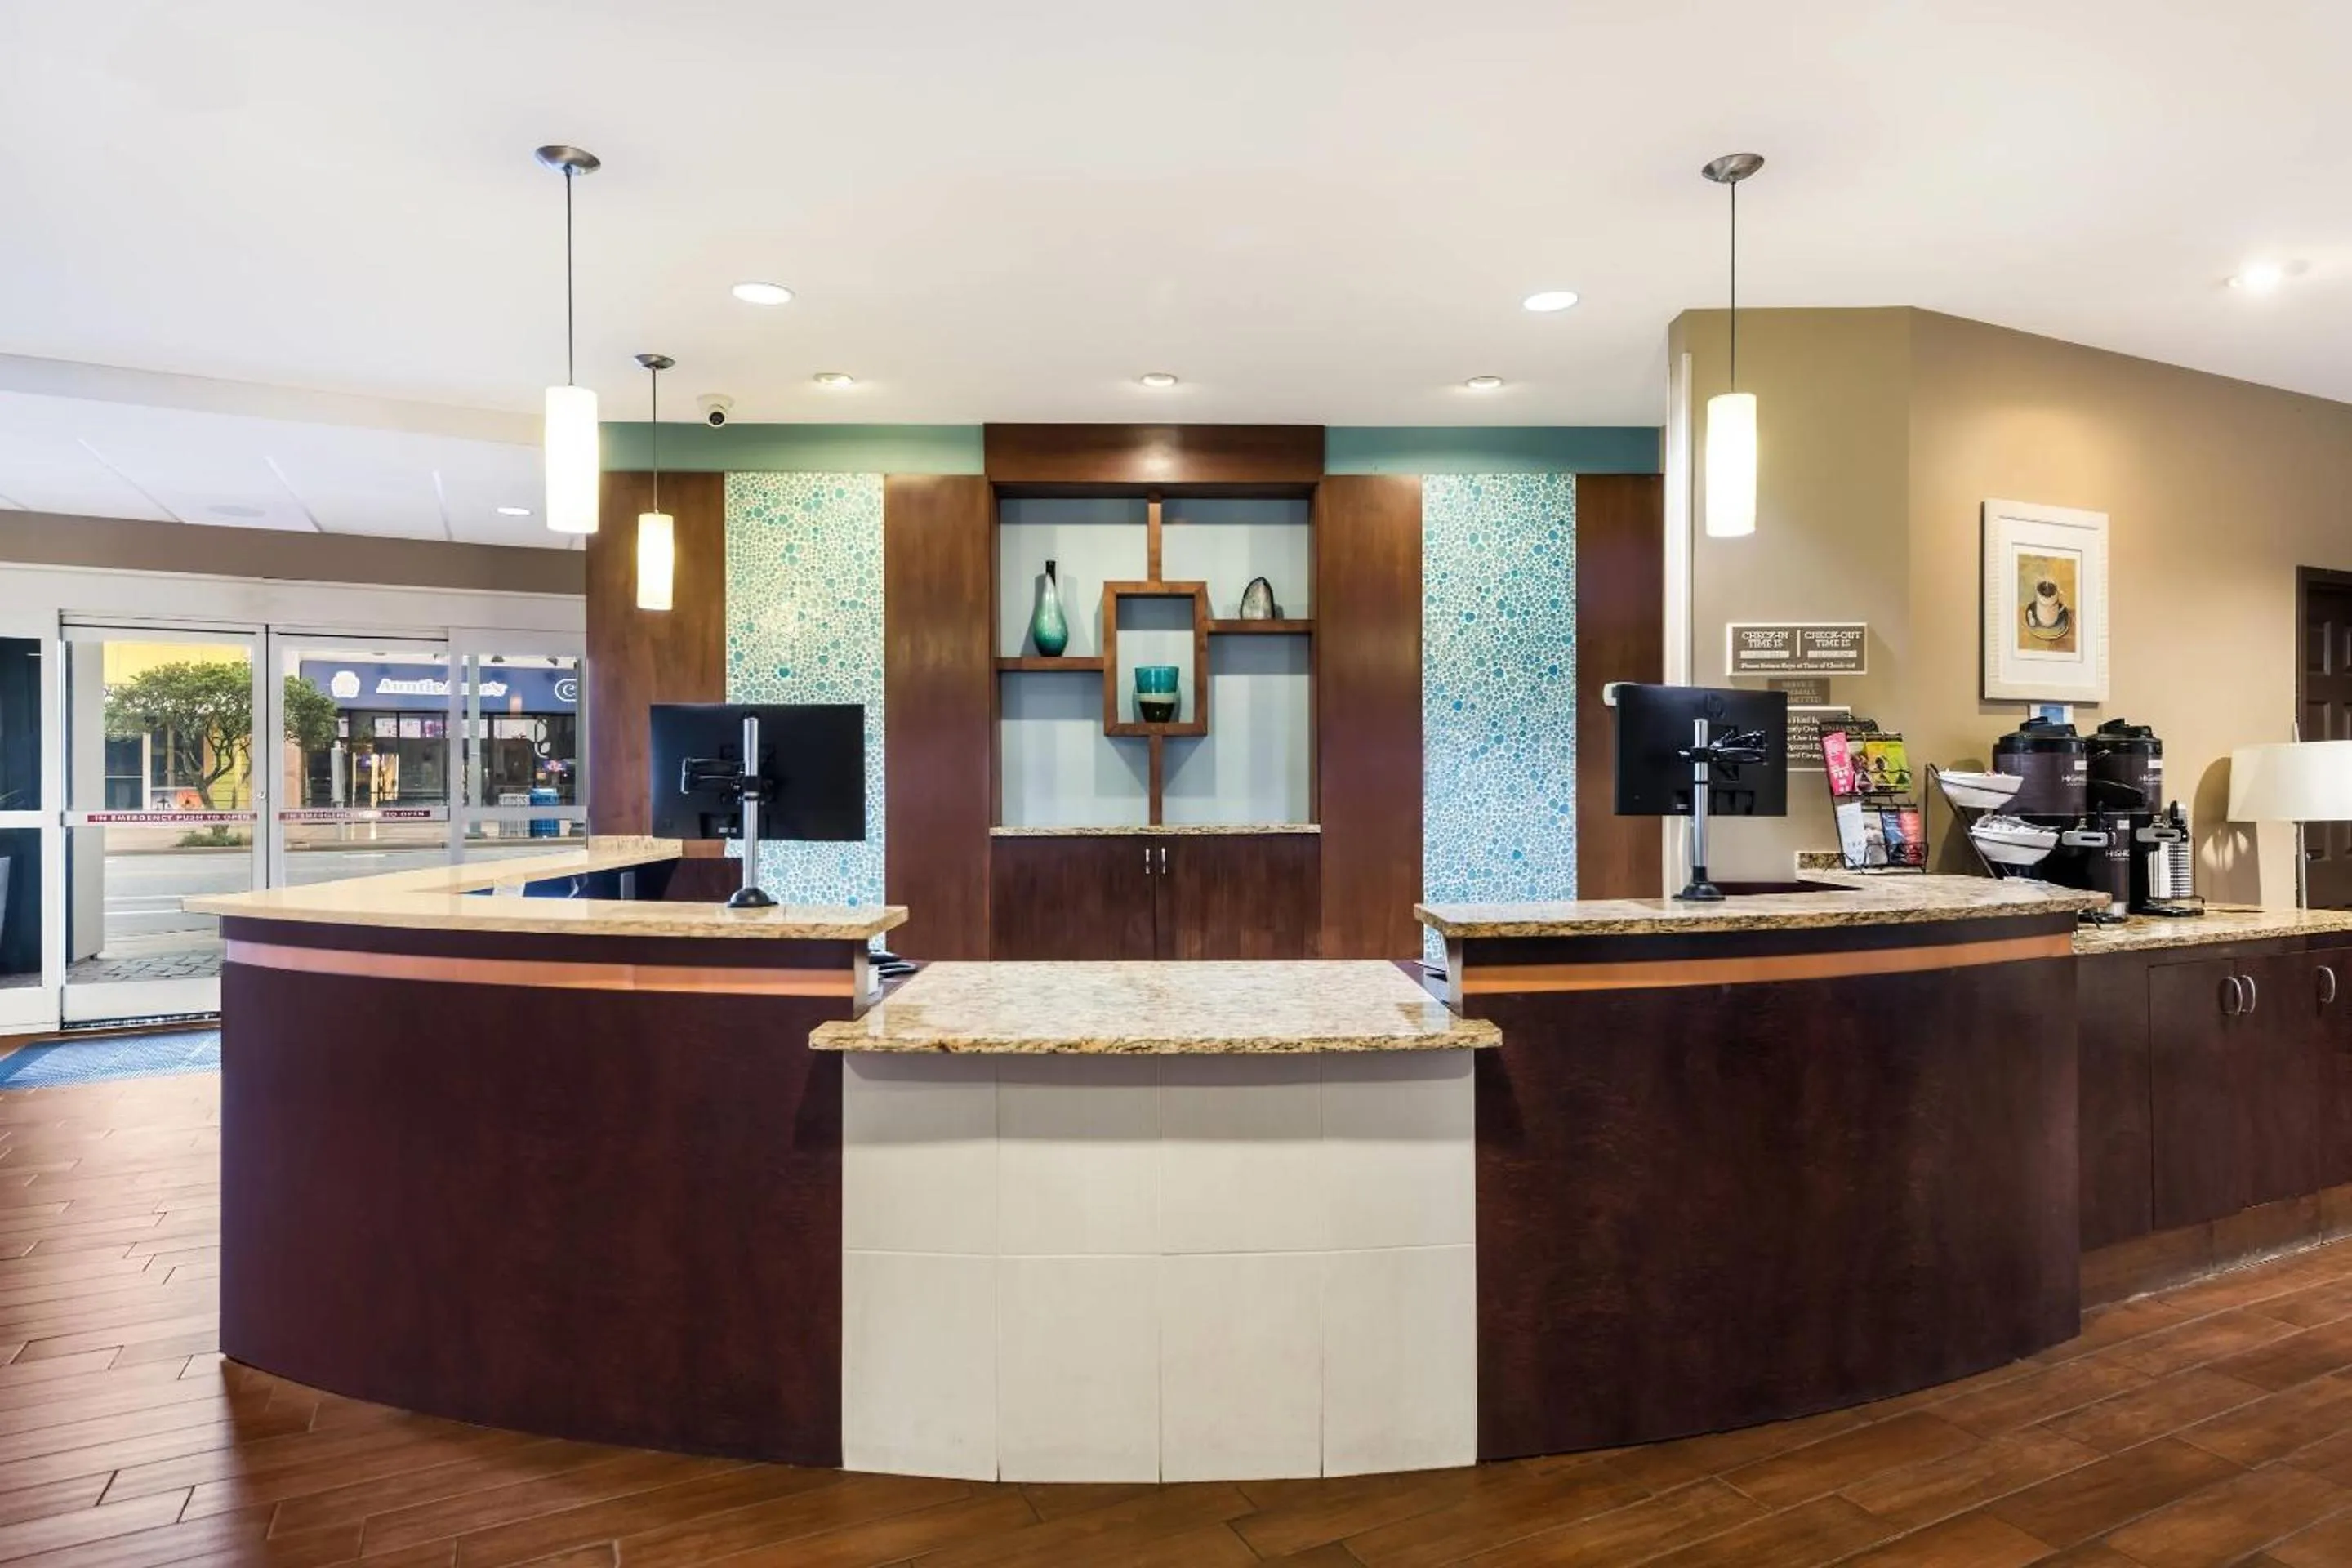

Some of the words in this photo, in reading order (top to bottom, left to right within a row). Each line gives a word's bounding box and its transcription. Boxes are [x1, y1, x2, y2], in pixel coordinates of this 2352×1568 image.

[1741, 631, 1789, 639] CHECK-IN
[1804, 631, 1862, 639] CHECK-OUT
[1748, 639, 1772, 648] TIME
[1773, 639, 1784, 648] IS
[376, 679, 445, 694] Auntie
